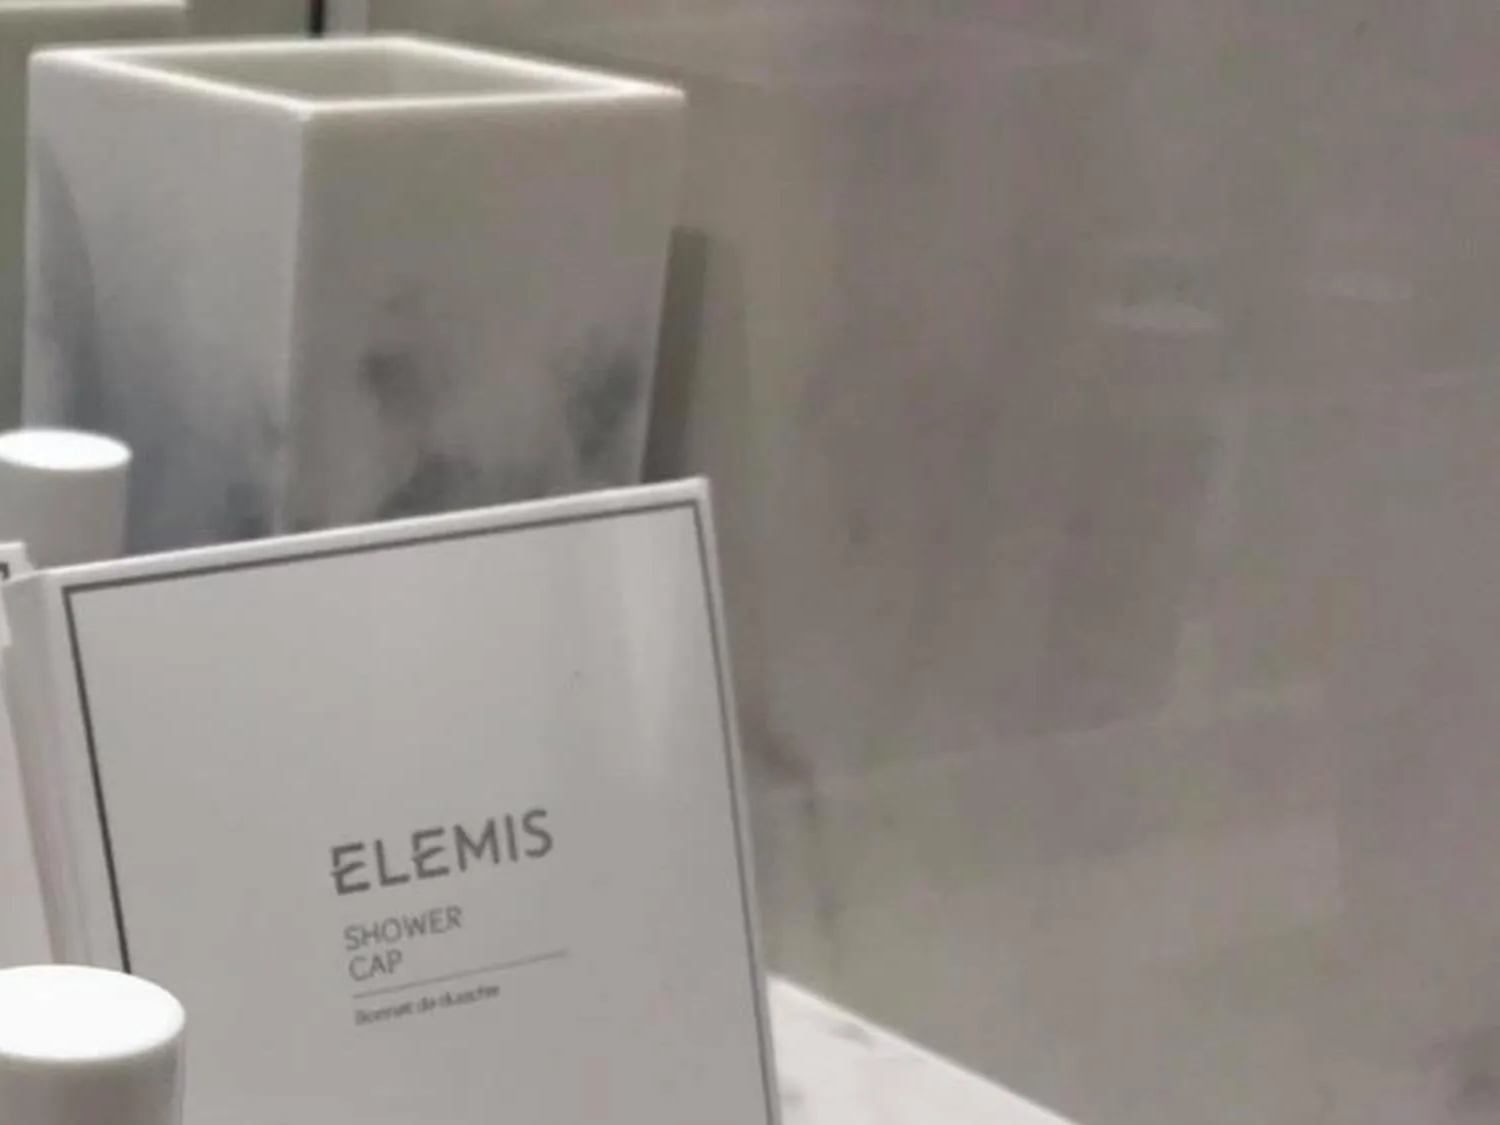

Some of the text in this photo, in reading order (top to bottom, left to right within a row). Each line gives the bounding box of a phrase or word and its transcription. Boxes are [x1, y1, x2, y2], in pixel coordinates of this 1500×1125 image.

[330, 808, 554, 896] ELEMIS
[344, 904, 463, 952] SHOWER
[348, 949, 403, 982] CAP
